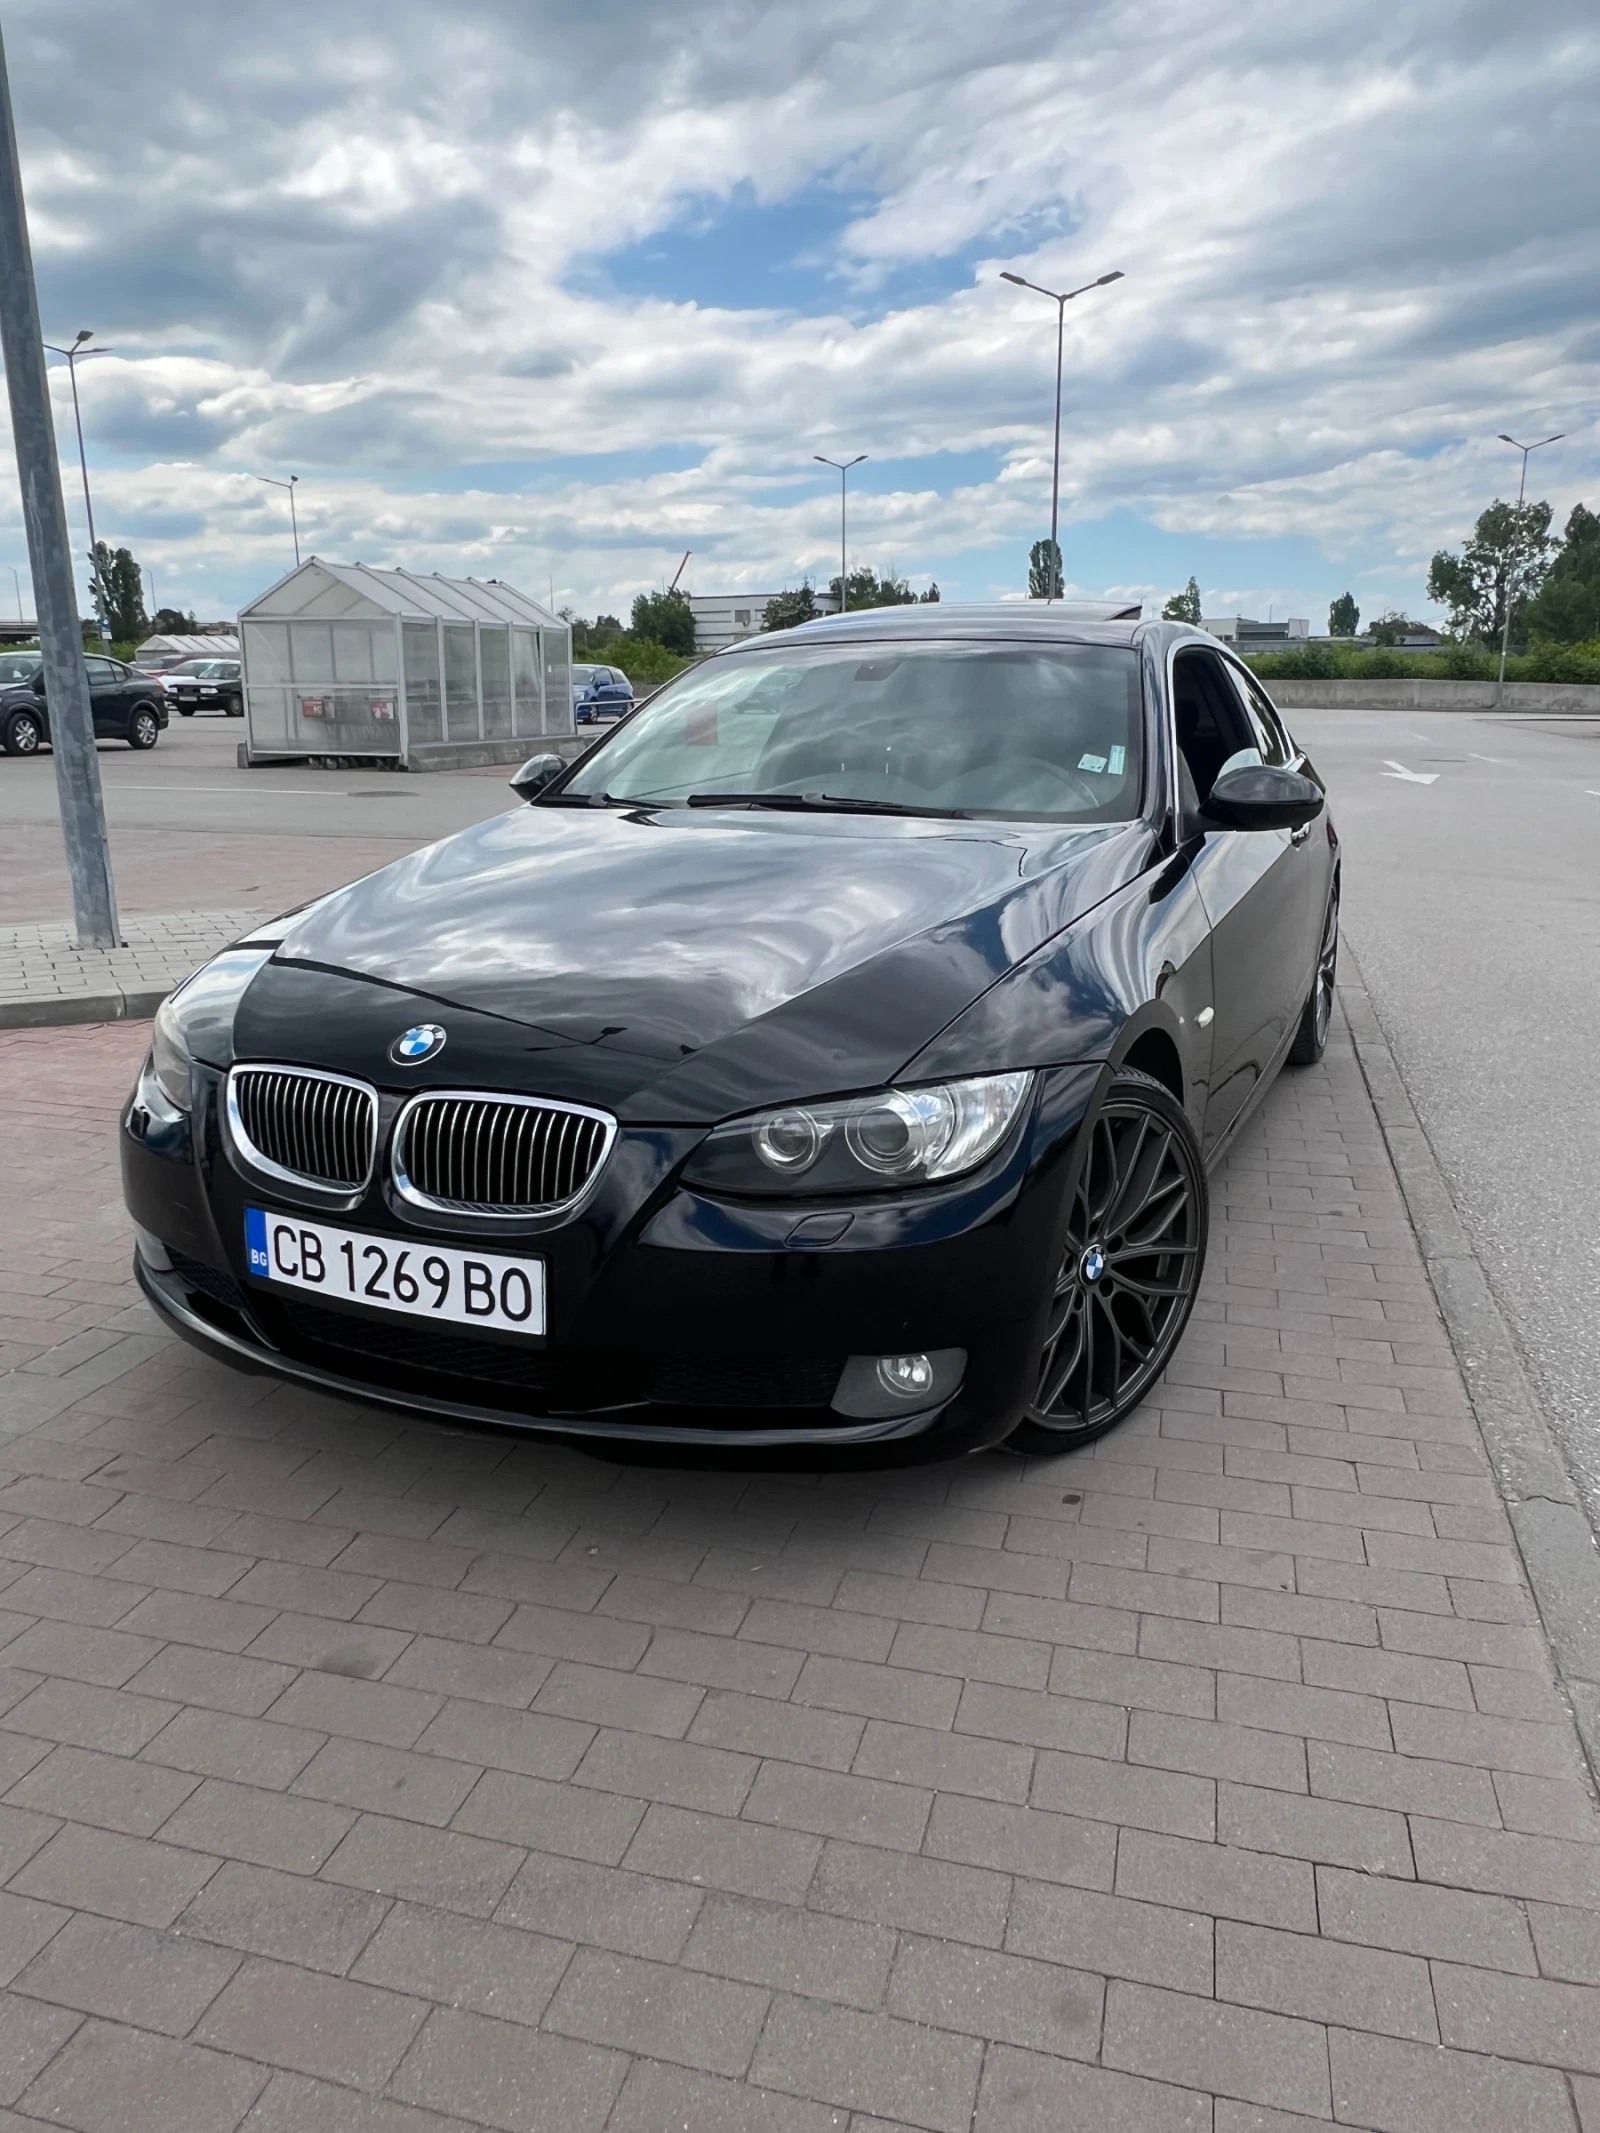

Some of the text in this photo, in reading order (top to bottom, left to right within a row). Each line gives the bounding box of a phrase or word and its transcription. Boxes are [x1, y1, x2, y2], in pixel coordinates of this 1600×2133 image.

[251, 1248, 268, 1267] BG
[273, 1224, 326, 1284] CB
[340, 1239, 451, 1309] 1269
